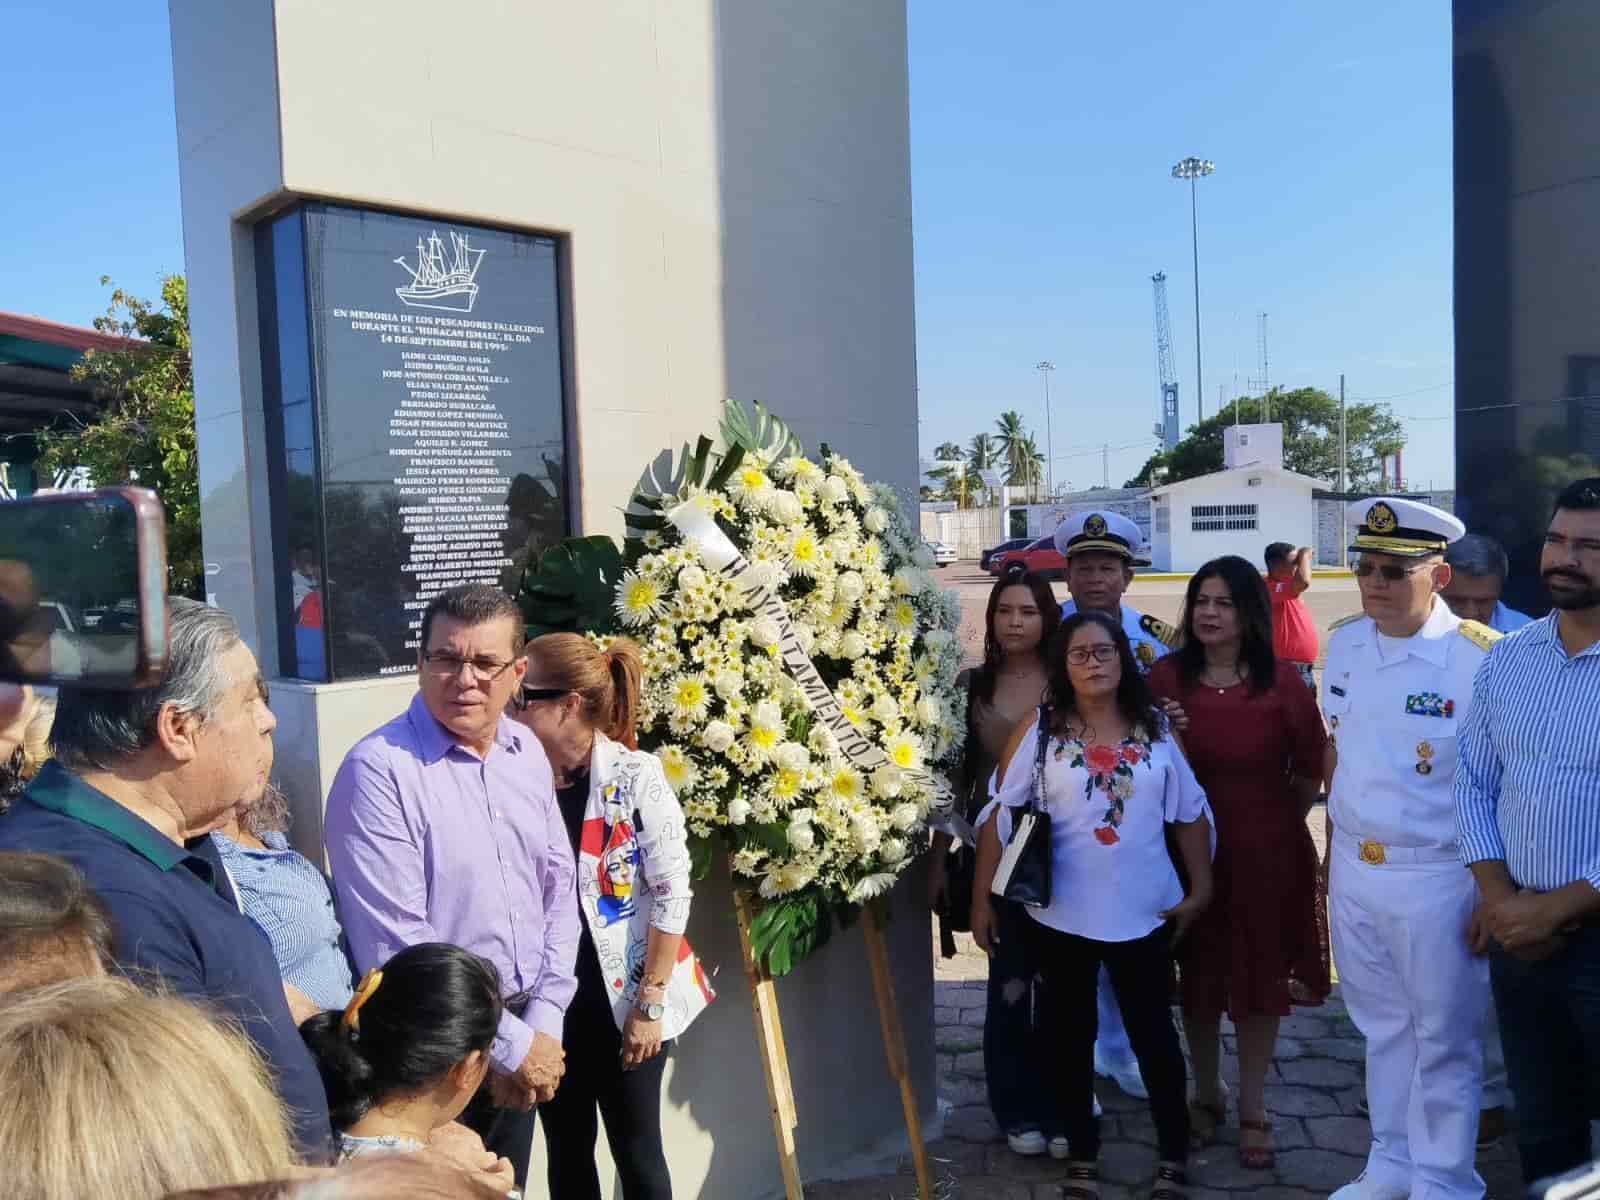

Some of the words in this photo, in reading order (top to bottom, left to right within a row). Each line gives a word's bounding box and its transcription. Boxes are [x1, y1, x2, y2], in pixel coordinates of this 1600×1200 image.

[350, 310, 398, 321] MEMORIA
[400, 314, 414, 322] DE
[416, 316, 432, 324] LOS
[434, 318, 492, 330] PESCADORES
[494, 322, 544, 334] FALLECIDOS
[352, 321, 400, 332] DURANTE
[402, 326, 414, 334] EL
[504, 334, 514, 342] EL
[394, 336, 409, 344] DE
[410, 337, 470, 349] SEPTIEMBRE
[470, 341, 482, 350] DE
[405, 372, 442, 380] ANTONIO
[411, 391, 440, 399] PEDRO
[394, 410, 436, 418] EDUARDO
